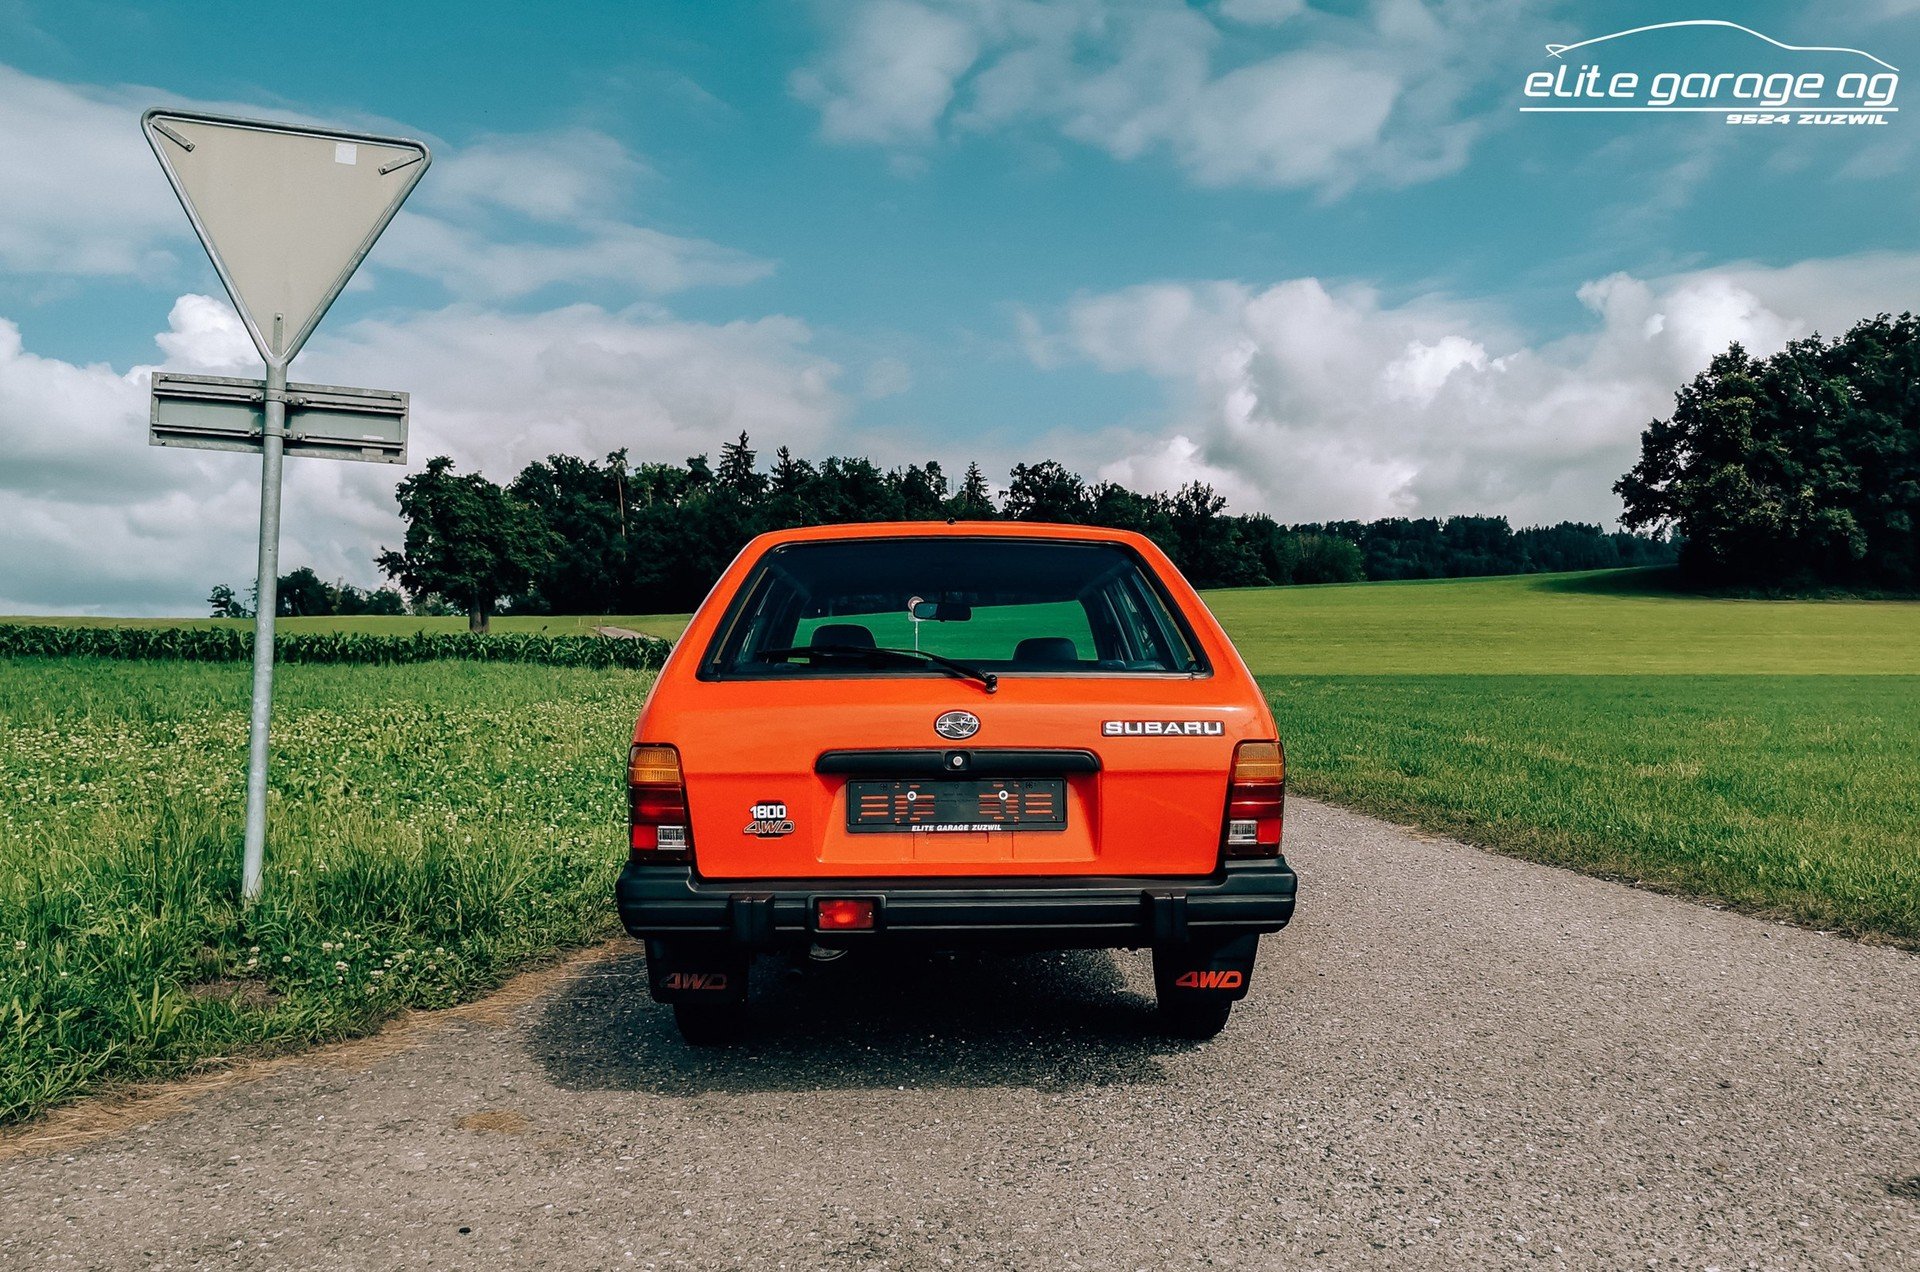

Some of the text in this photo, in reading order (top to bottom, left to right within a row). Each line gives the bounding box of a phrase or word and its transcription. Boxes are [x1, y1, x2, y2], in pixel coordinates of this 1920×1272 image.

[1105, 721, 1222, 735] SUBARU
[749, 805, 787, 819] 1800
[743, 820, 795, 834] 4WD
[1175, 970, 1242, 988] 4WD
